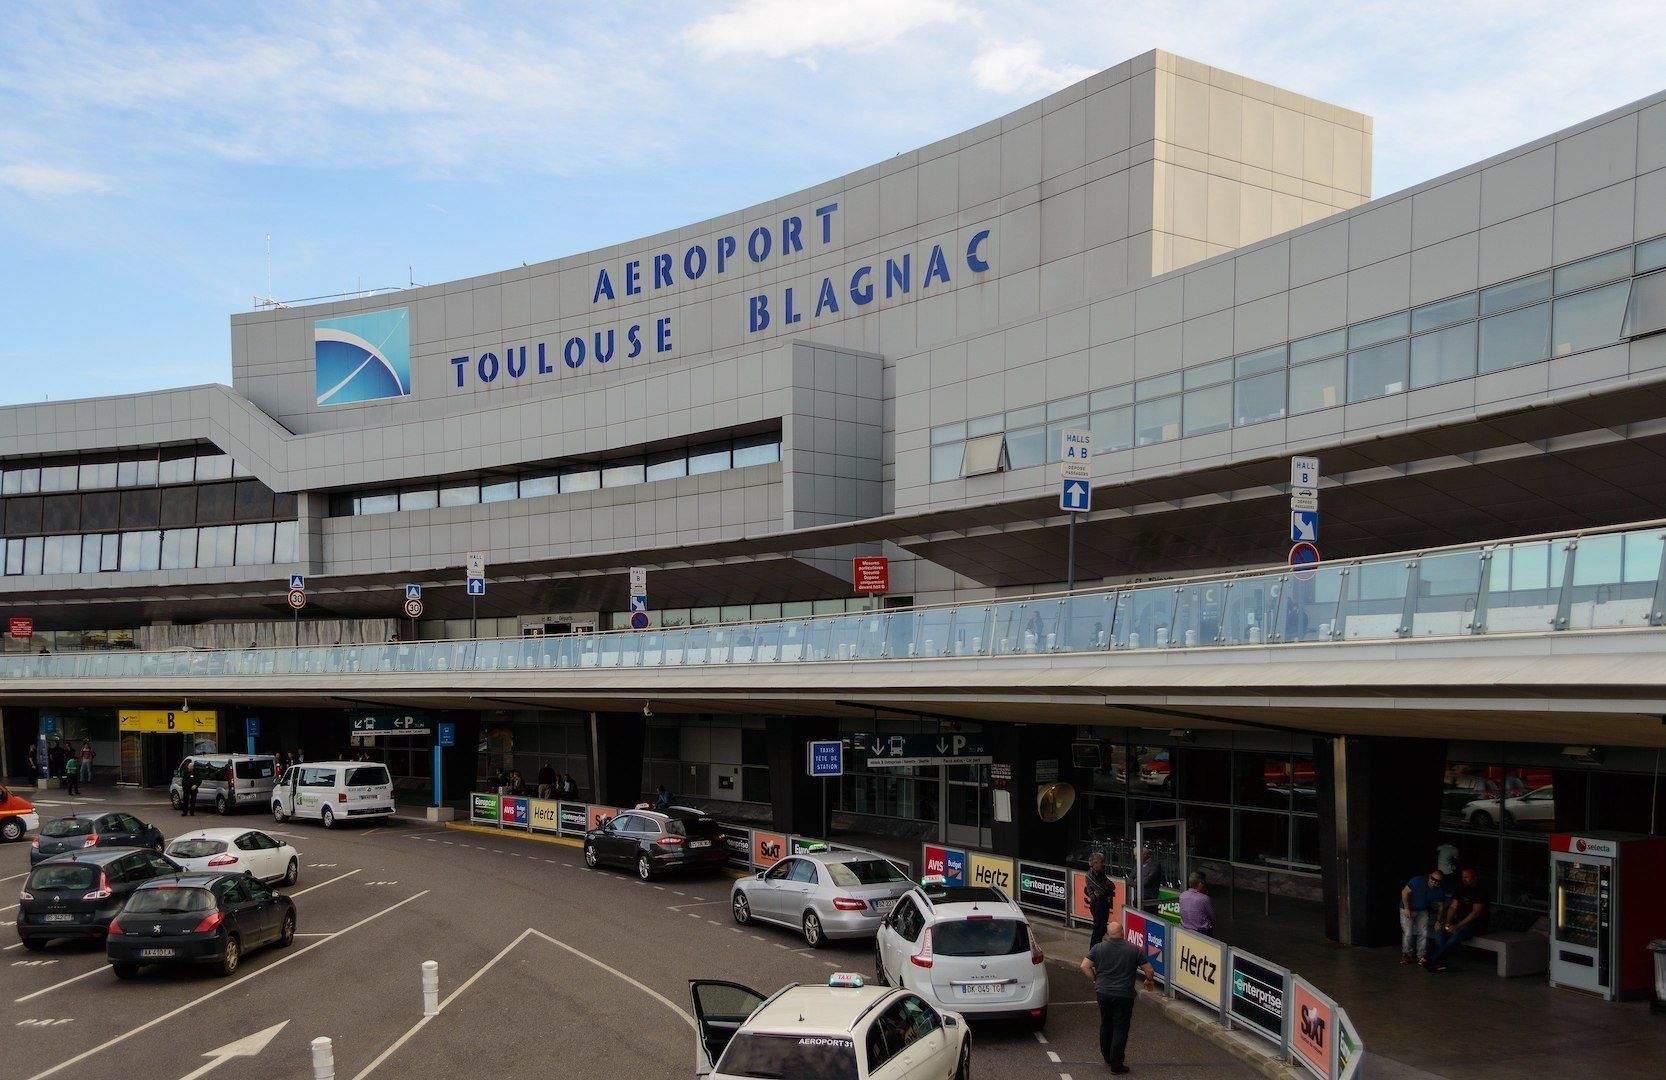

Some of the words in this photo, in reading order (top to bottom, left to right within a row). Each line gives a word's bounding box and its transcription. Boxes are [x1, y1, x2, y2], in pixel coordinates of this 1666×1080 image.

[592, 203, 839, 304] AEROPORT
[450, 317, 674, 388] TOULOUSE
[748, 229, 991, 333] BLAGNAC
[1066, 434, 1090, 443] HALLS
[1068, 446, 1075, 458] A
[1081, 448, 1088, 459] B
[1296, 462, 1315, 470] HALL
[1302, 473, 1309, 483] B
[409, 604, 419, 612] 30
[167, 712, 175, 729] B
[405, 716, 414, 728] P
[953, 735, 967, 755] P
[475, 797, 497, 807] Europcar
[503, 806, 515, 814] AVIS
[534, 807, 554, 820] Hertz
[1587, 842, 1610, 852] selecta
[928, 859, 944, 872] AVIS
[947, 860, 962, 870] Budget
[975, 865, 1009, 887] Hertz
[1023, 879, 1065, 894] enterprise
[1127, 929, 1144, 948] AVIS
[1147, 932, 1162, 948] Budget
[1179, 945, 1217, 985] Hertz
[1236, 978, 1282, 1008] enterprise
[798, 1038, 844, 1047] AEROPORT
[844, 1040, 853, 1048] 31
